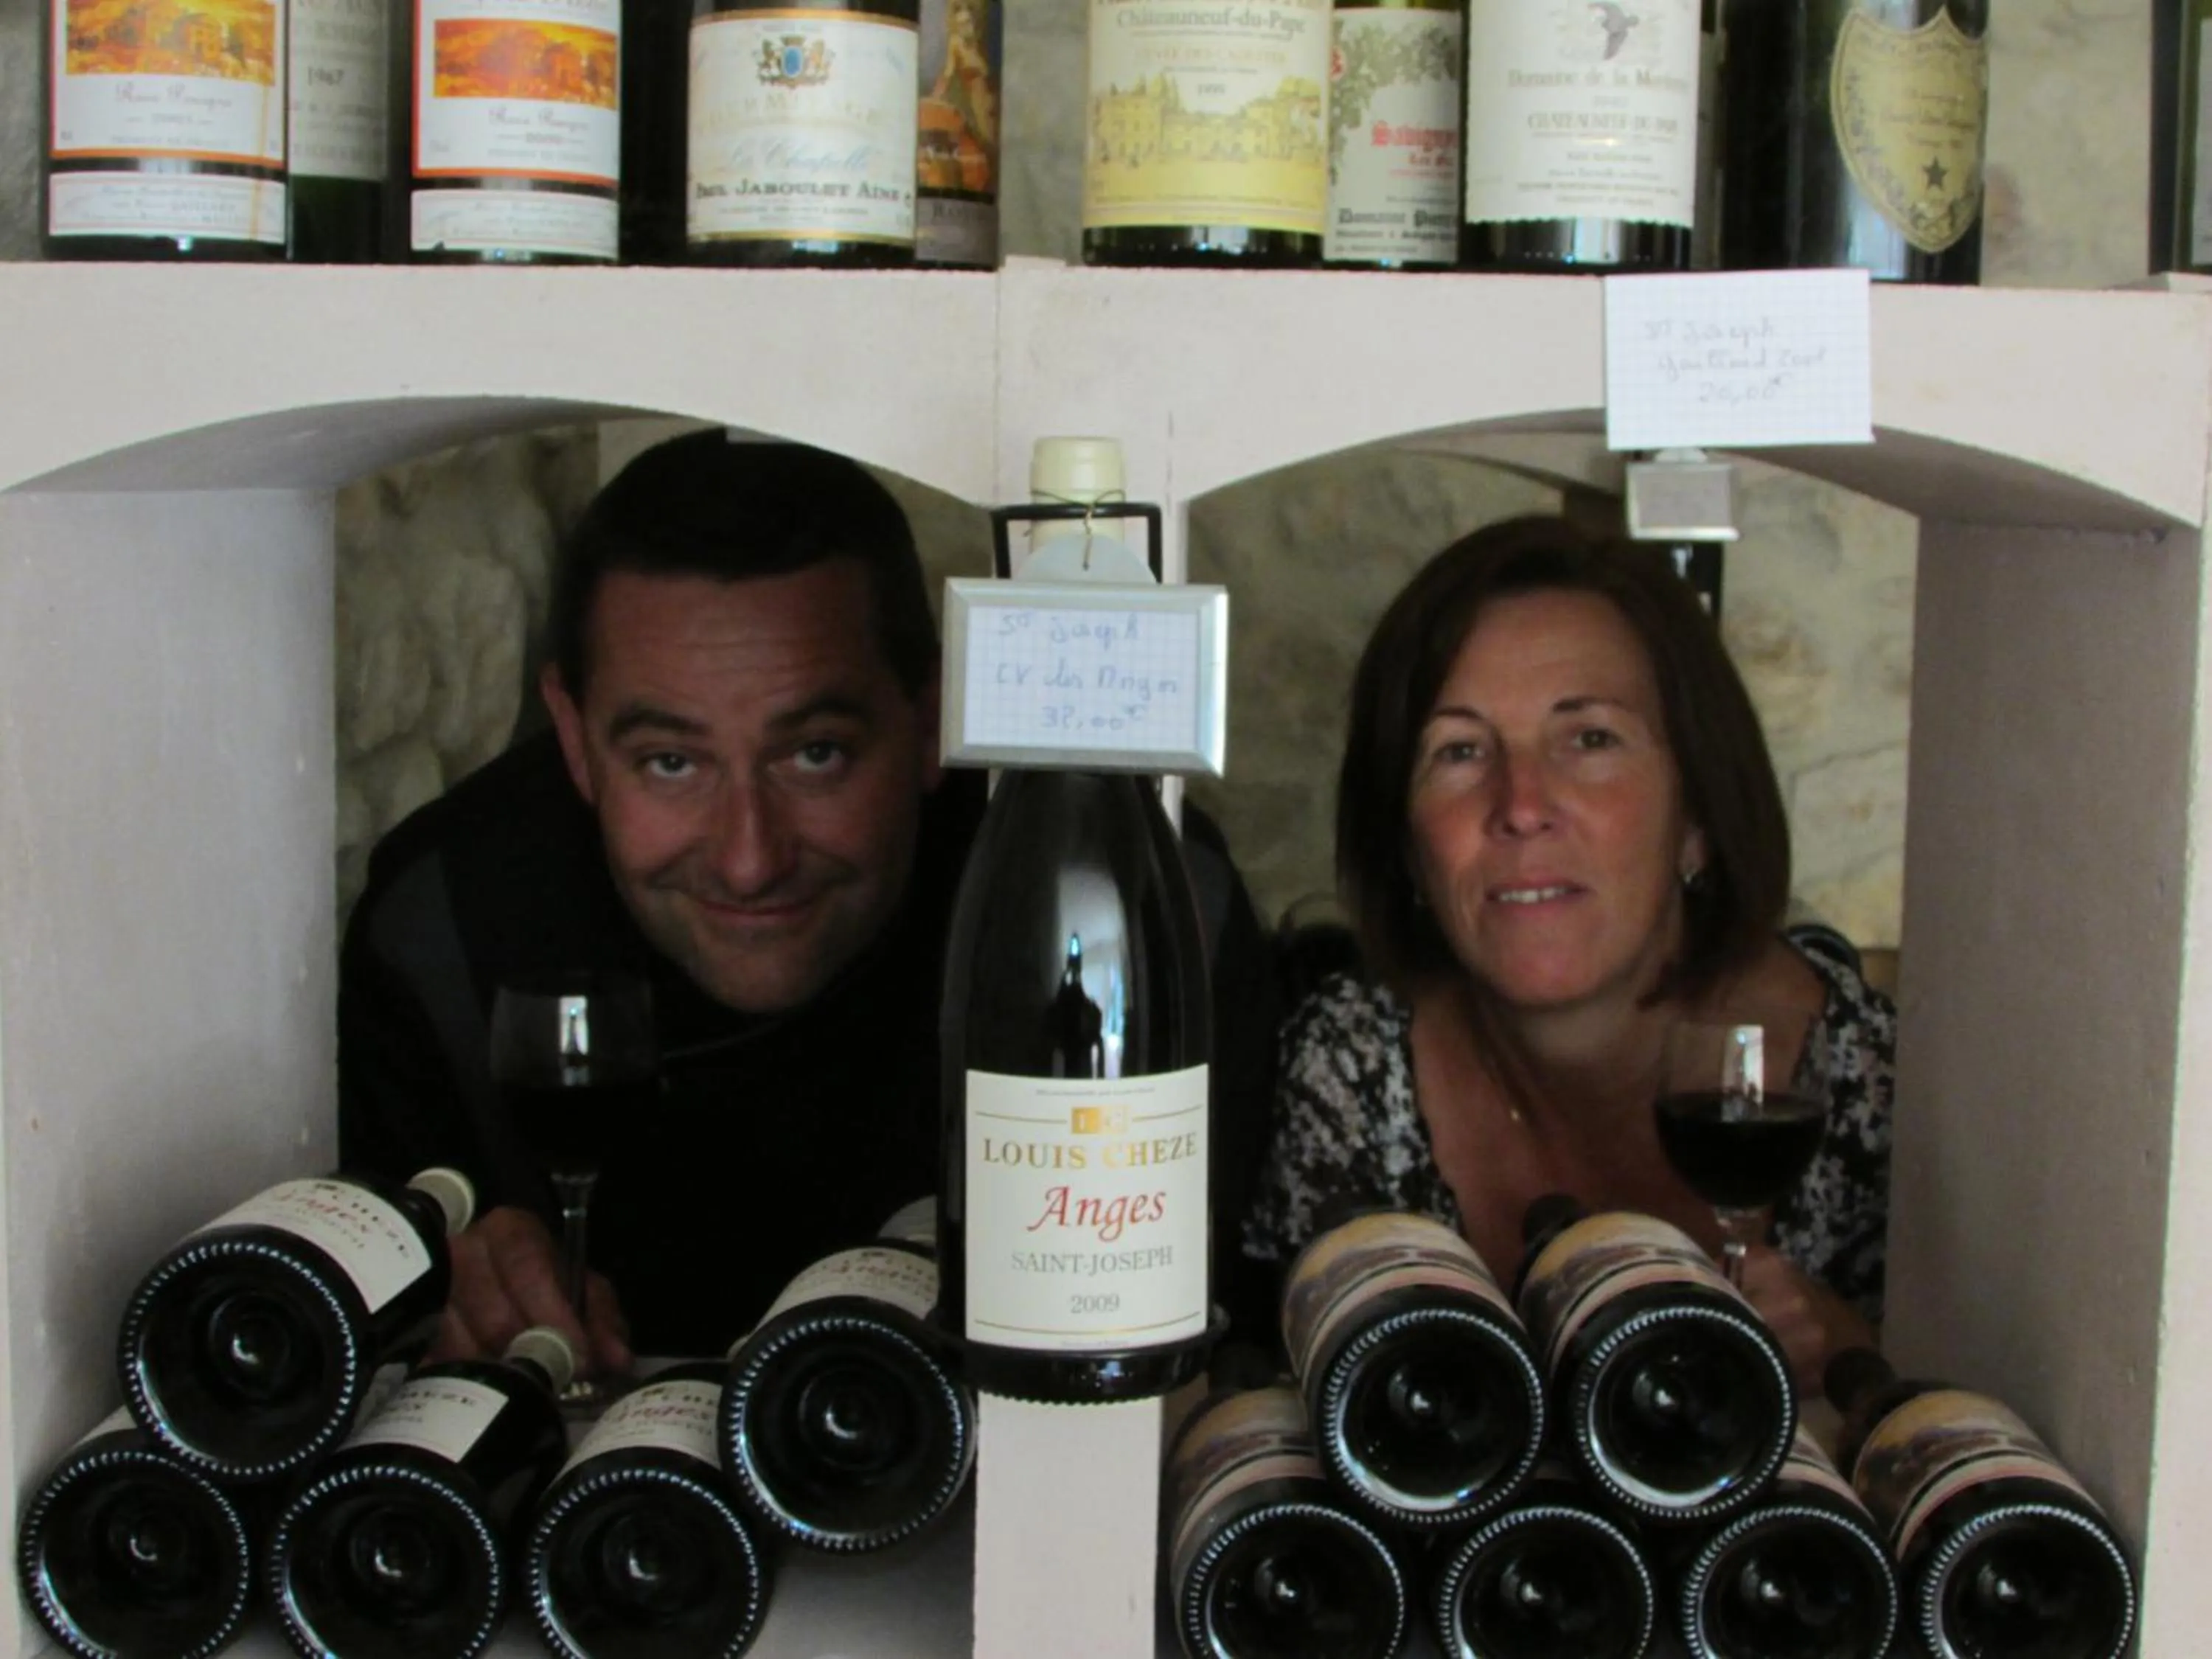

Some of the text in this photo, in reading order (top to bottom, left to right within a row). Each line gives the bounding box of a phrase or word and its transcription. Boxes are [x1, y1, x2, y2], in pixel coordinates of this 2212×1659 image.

[982, 1131, 1198, 1169] LOUIS CHEZE
[1026, 1184, 1166, 1243] Anges
[1010, 1245, 1174, 1277] SAINT-JOSEPH
[1070, 1293, 1121, 1315] 2009
